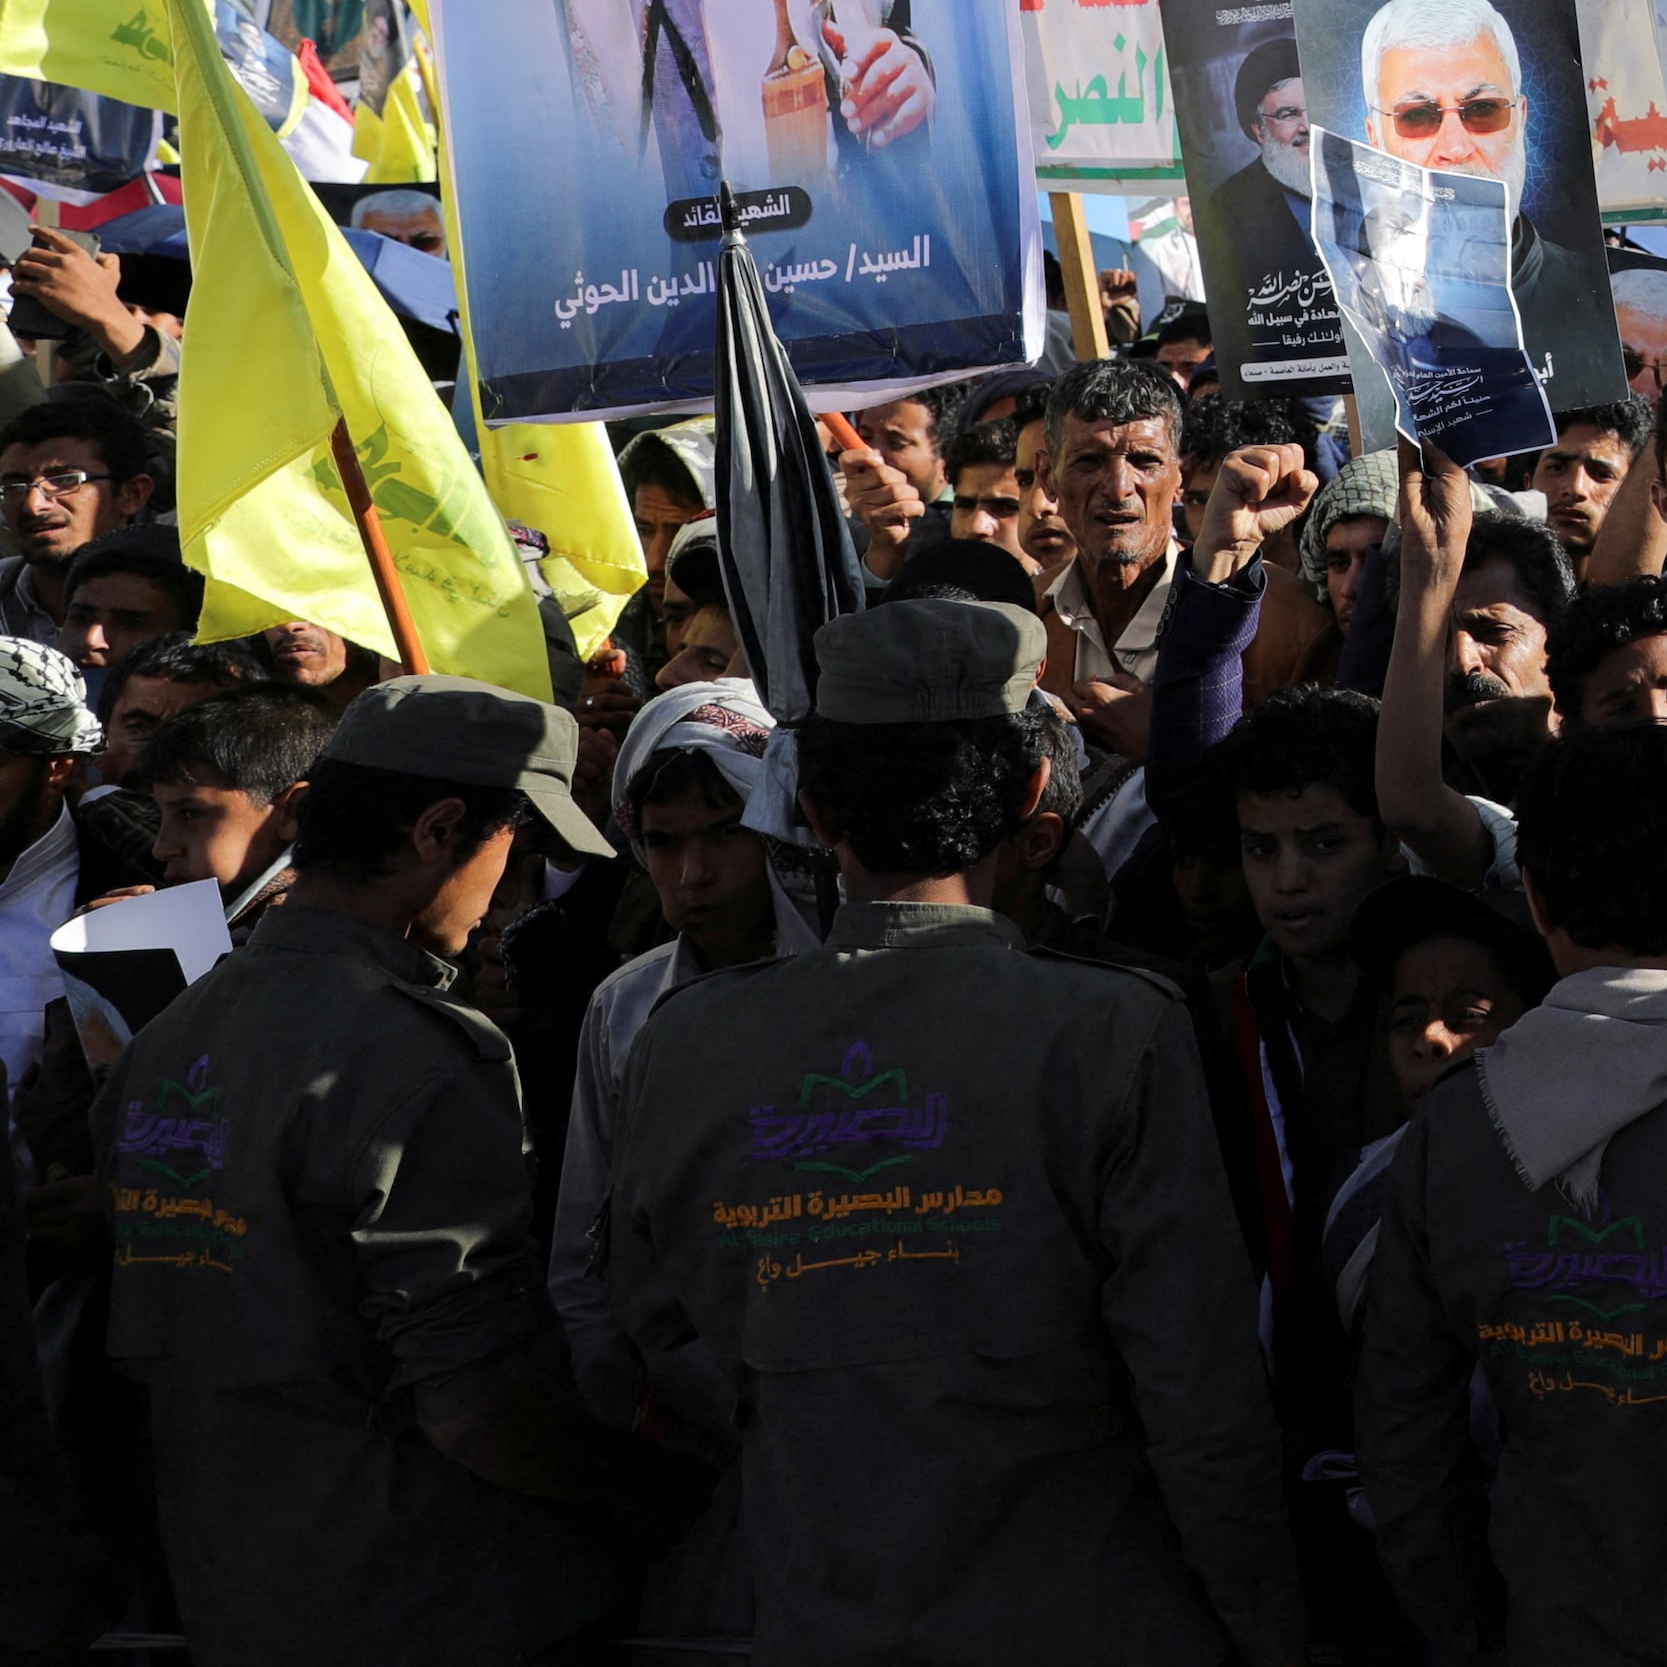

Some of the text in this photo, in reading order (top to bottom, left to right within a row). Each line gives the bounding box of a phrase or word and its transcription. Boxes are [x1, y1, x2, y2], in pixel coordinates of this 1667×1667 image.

[1046, 29, 1165, 151] النصر
[682, 193, 791, 228] الشهي لقائد
[646, 262, 716, 307] الدين
[764, 257, 838, 294] حسين
[554, 268, 639, 329] الحوثي
[1247, 309, 1310, 328] في سبيل الله
[1282, 333, 1306, 347] رفيقا
[712, 1185, 1004, 1229] مدارس البصيرة التربوية
[786, 1248, 883, 1278] جيل
[887, 1239, 961, 1266] بناء
